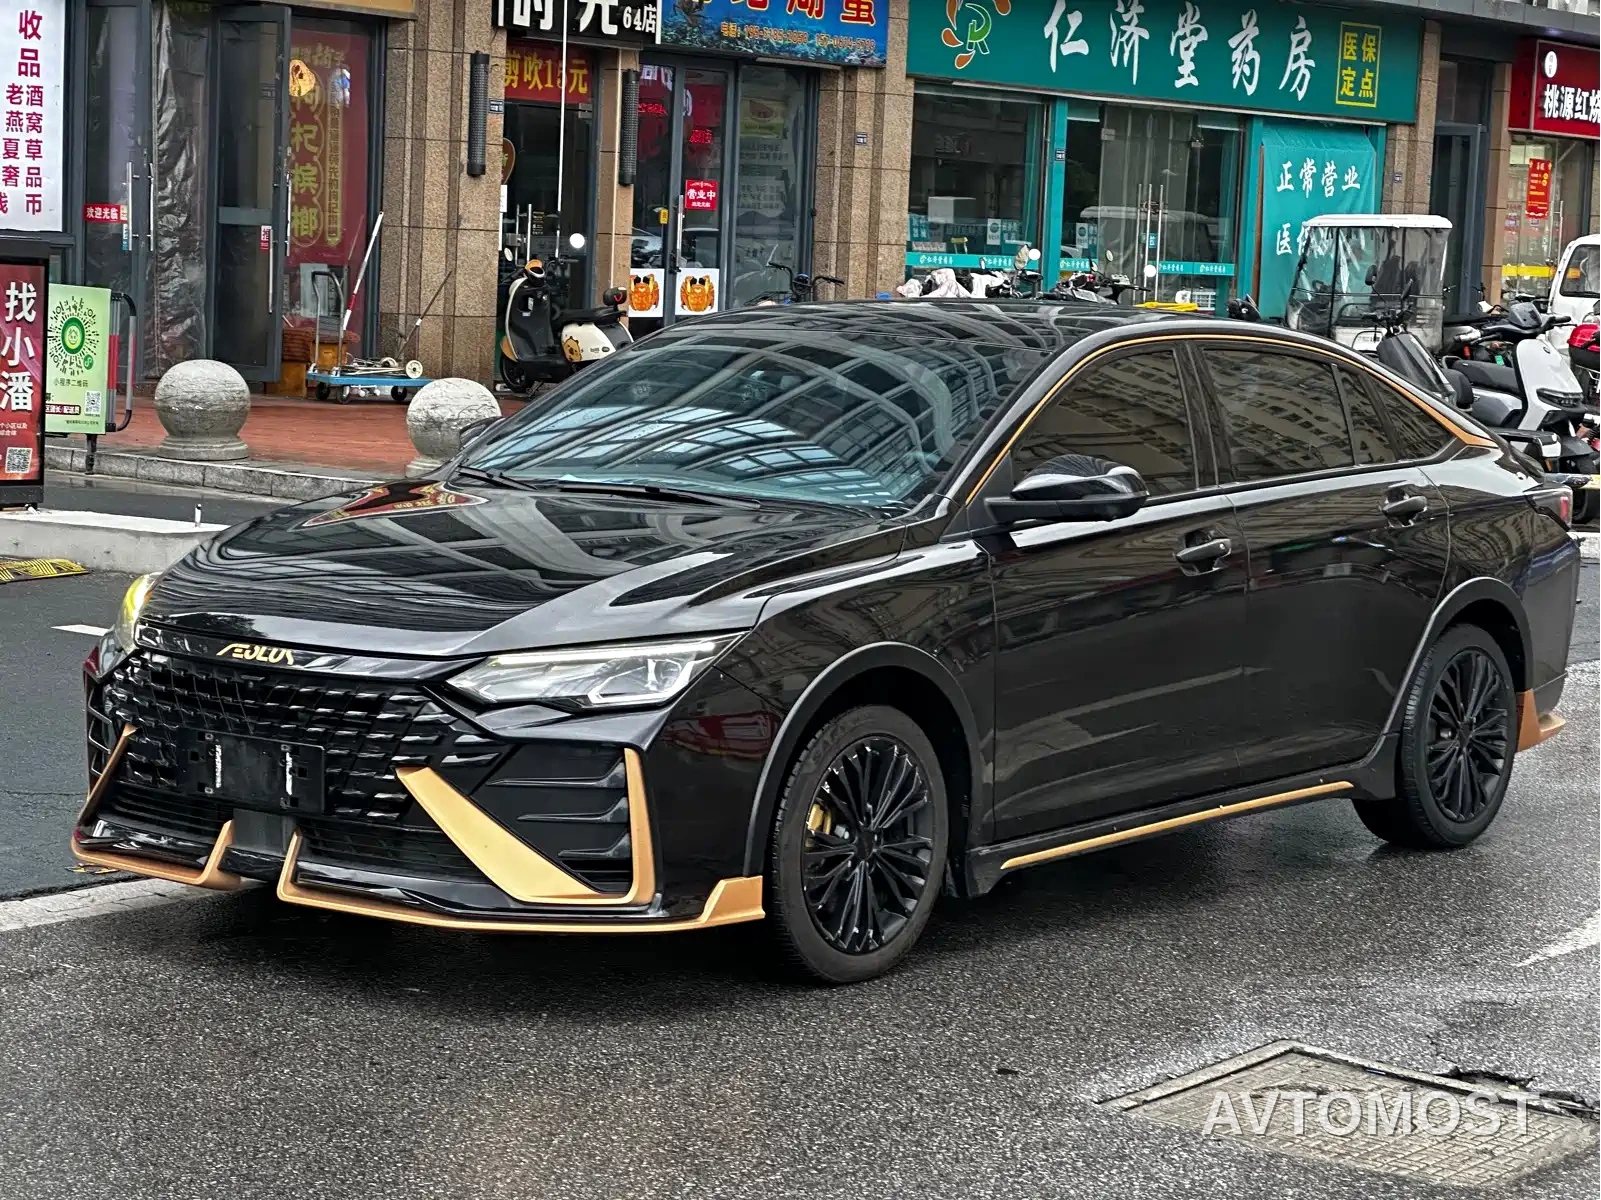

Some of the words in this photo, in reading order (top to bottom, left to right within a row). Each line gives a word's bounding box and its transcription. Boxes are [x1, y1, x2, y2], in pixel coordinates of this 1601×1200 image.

[19, 10, 43, 40] 收
[622, 4, 657, 33] 64店
[1043, 0, 1315, 101] 仁济堂药房
[1342, 31, 1376, 63] 医保
[18, 48, 41, 78] 品
[6, 83, 44, 108] 老酒
[1340, 67, 1375, 98] 定点
[5, 111, 43, 134] 燕窝
[2, 138, 43, 161] 夏草
[2, 165, 42, 188] 奢品
[1276, 157, 1361, 198] 正常营业
[687, 188, 716, 201] 营业中
[86, 206, 119, 220] 欢迎光临
[0, 281, 37, 411] 找小潘
